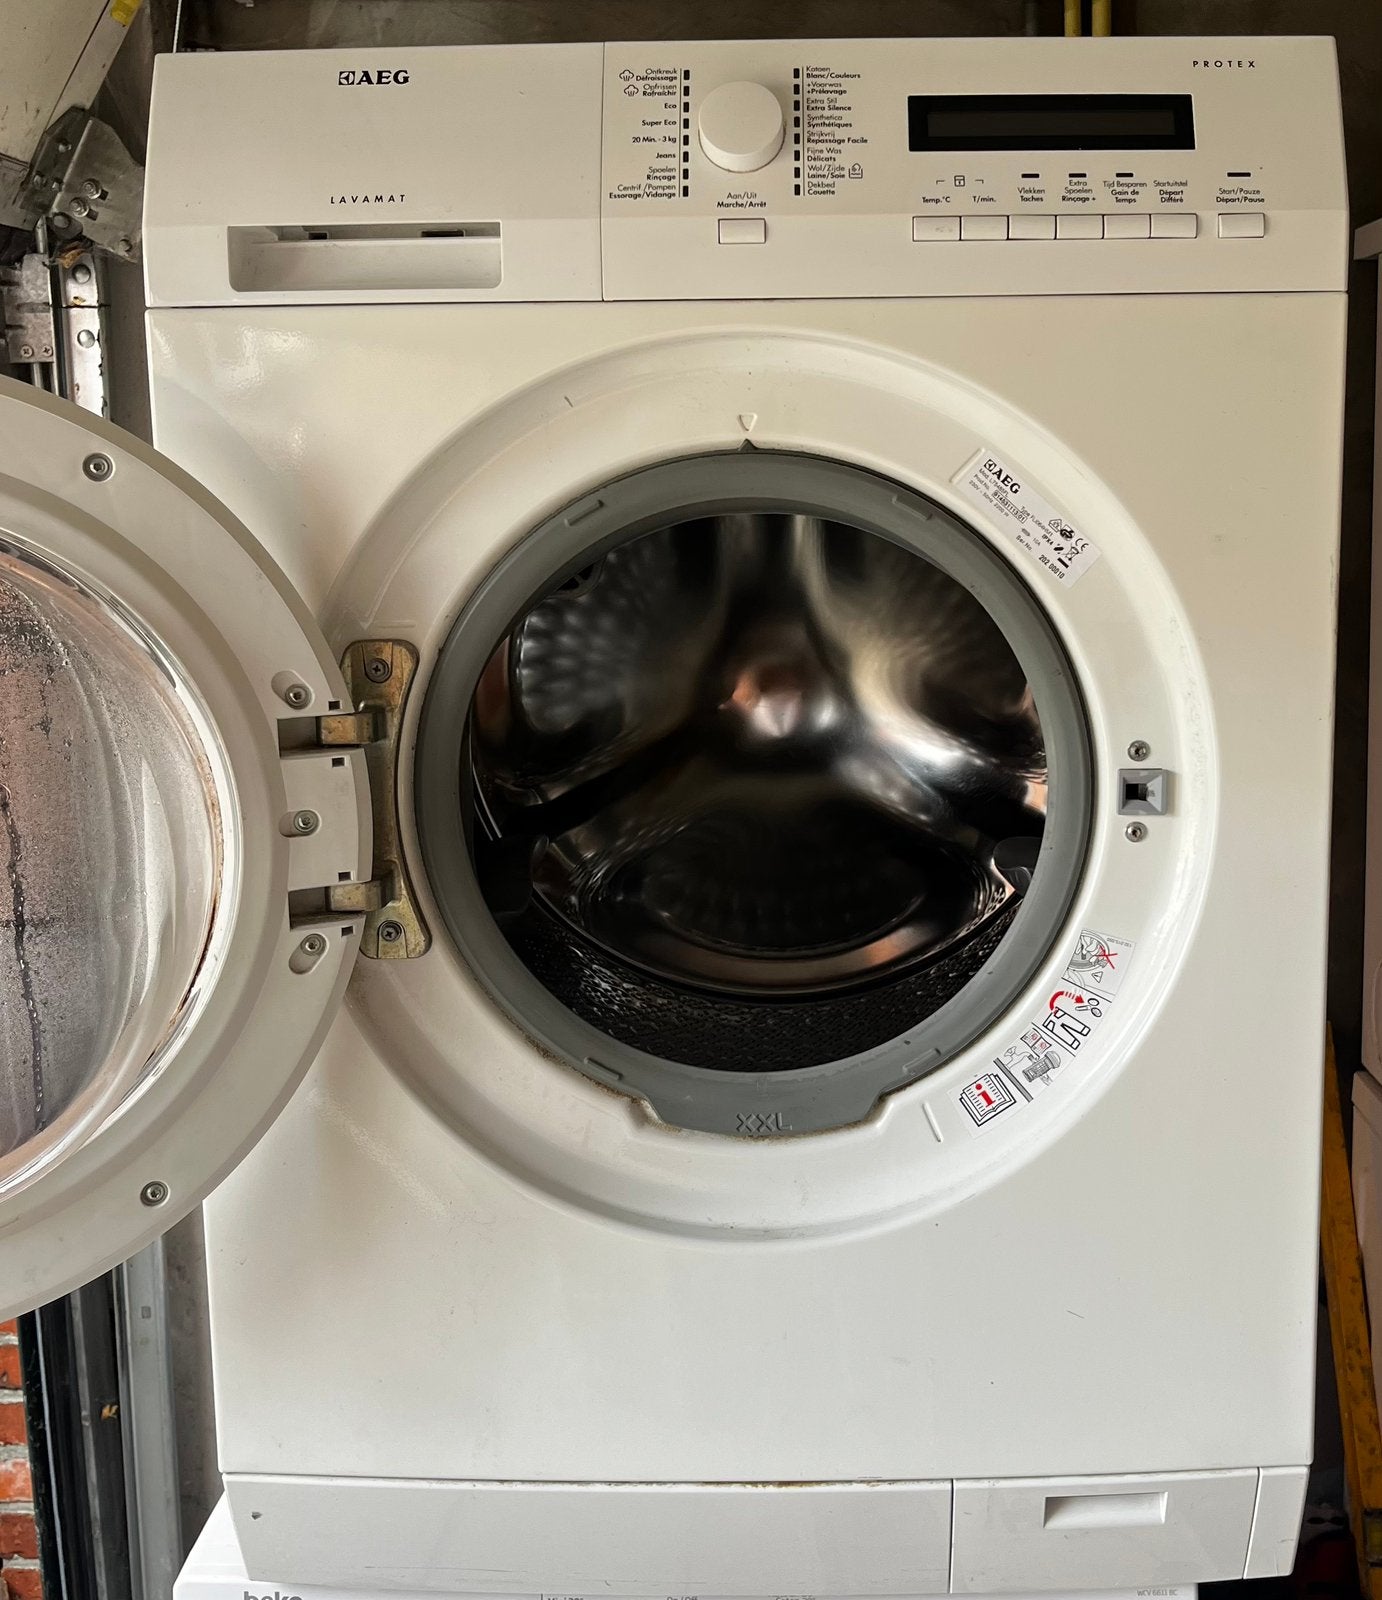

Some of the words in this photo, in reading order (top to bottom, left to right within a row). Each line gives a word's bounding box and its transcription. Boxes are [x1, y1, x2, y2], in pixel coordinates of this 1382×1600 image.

[1192, 60, 1255, 68] PROTEX
[356, 70, 410, 85] AEG
[643, 83, 677, 91] Opfrissen
[807, 114, 843, 122] Synthetica
[807, 121, 853, 129] Synthétiques
[807, 130, 836, 138] Strijkvrij
[807, 147, 824, 155] Fijne
[648, 166, 676, 174] Spoelen
[807, 164, 845, 173] Wol/Zijde
[1068, 179, 1087, 187] Extra
[1103, 180, 1115, 189] Tijd
[1116, 181, 1147, 189] Besparen
[1153, 179, 1188, 187] Startuitstel
[807, 188, 836, 196] Couette
[1064, 186, 1093, 194] Spoelen
[1159, 189, 1184, 197] Départ
[1218, 187, 1261, 195] Start/Pauze
[330, 194, 406, 204] LAVAMAT
[609, 190, 676, 200] Essorage/Vidange
[726, 191, 757, 200] Aan/Uit
[1061, 195, 1090, 203] Rinçage
[972, 195, 997, 204] T/min.
[1115, 196, 1137, 204] Temps
[1216, 196, 1265, 204] Départ/Pause
[716, 200, 767, 209] Marche/Arrêt
[992, 468, 1021, 494] AEG
[736, 1112, 792, 1132] XXL
